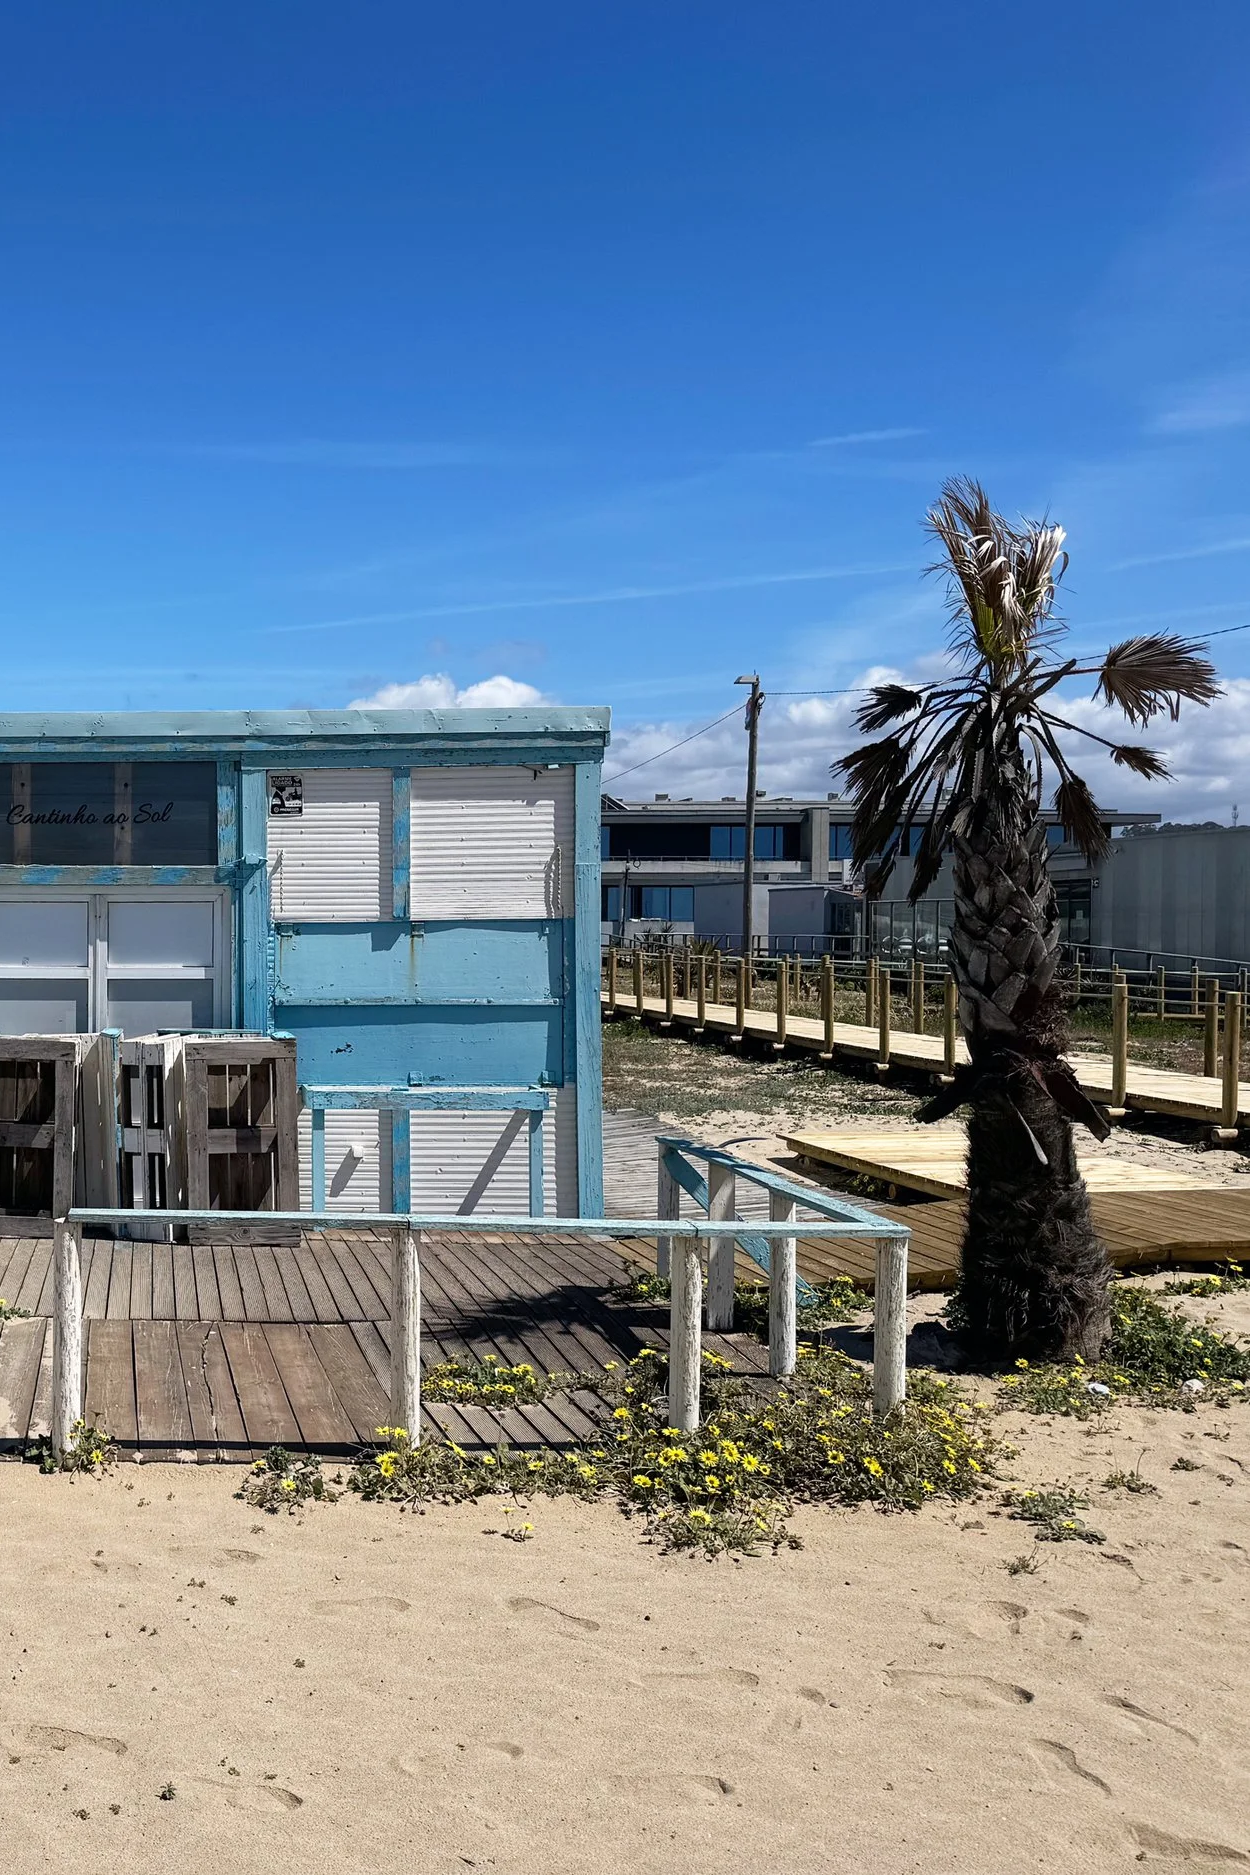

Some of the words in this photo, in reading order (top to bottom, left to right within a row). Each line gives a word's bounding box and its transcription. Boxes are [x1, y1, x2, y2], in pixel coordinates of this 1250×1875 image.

[6, 804, 98, 825] Cantinho
[103, 813, 129, 825] ao
[133, 801, 174, 824] Sol
